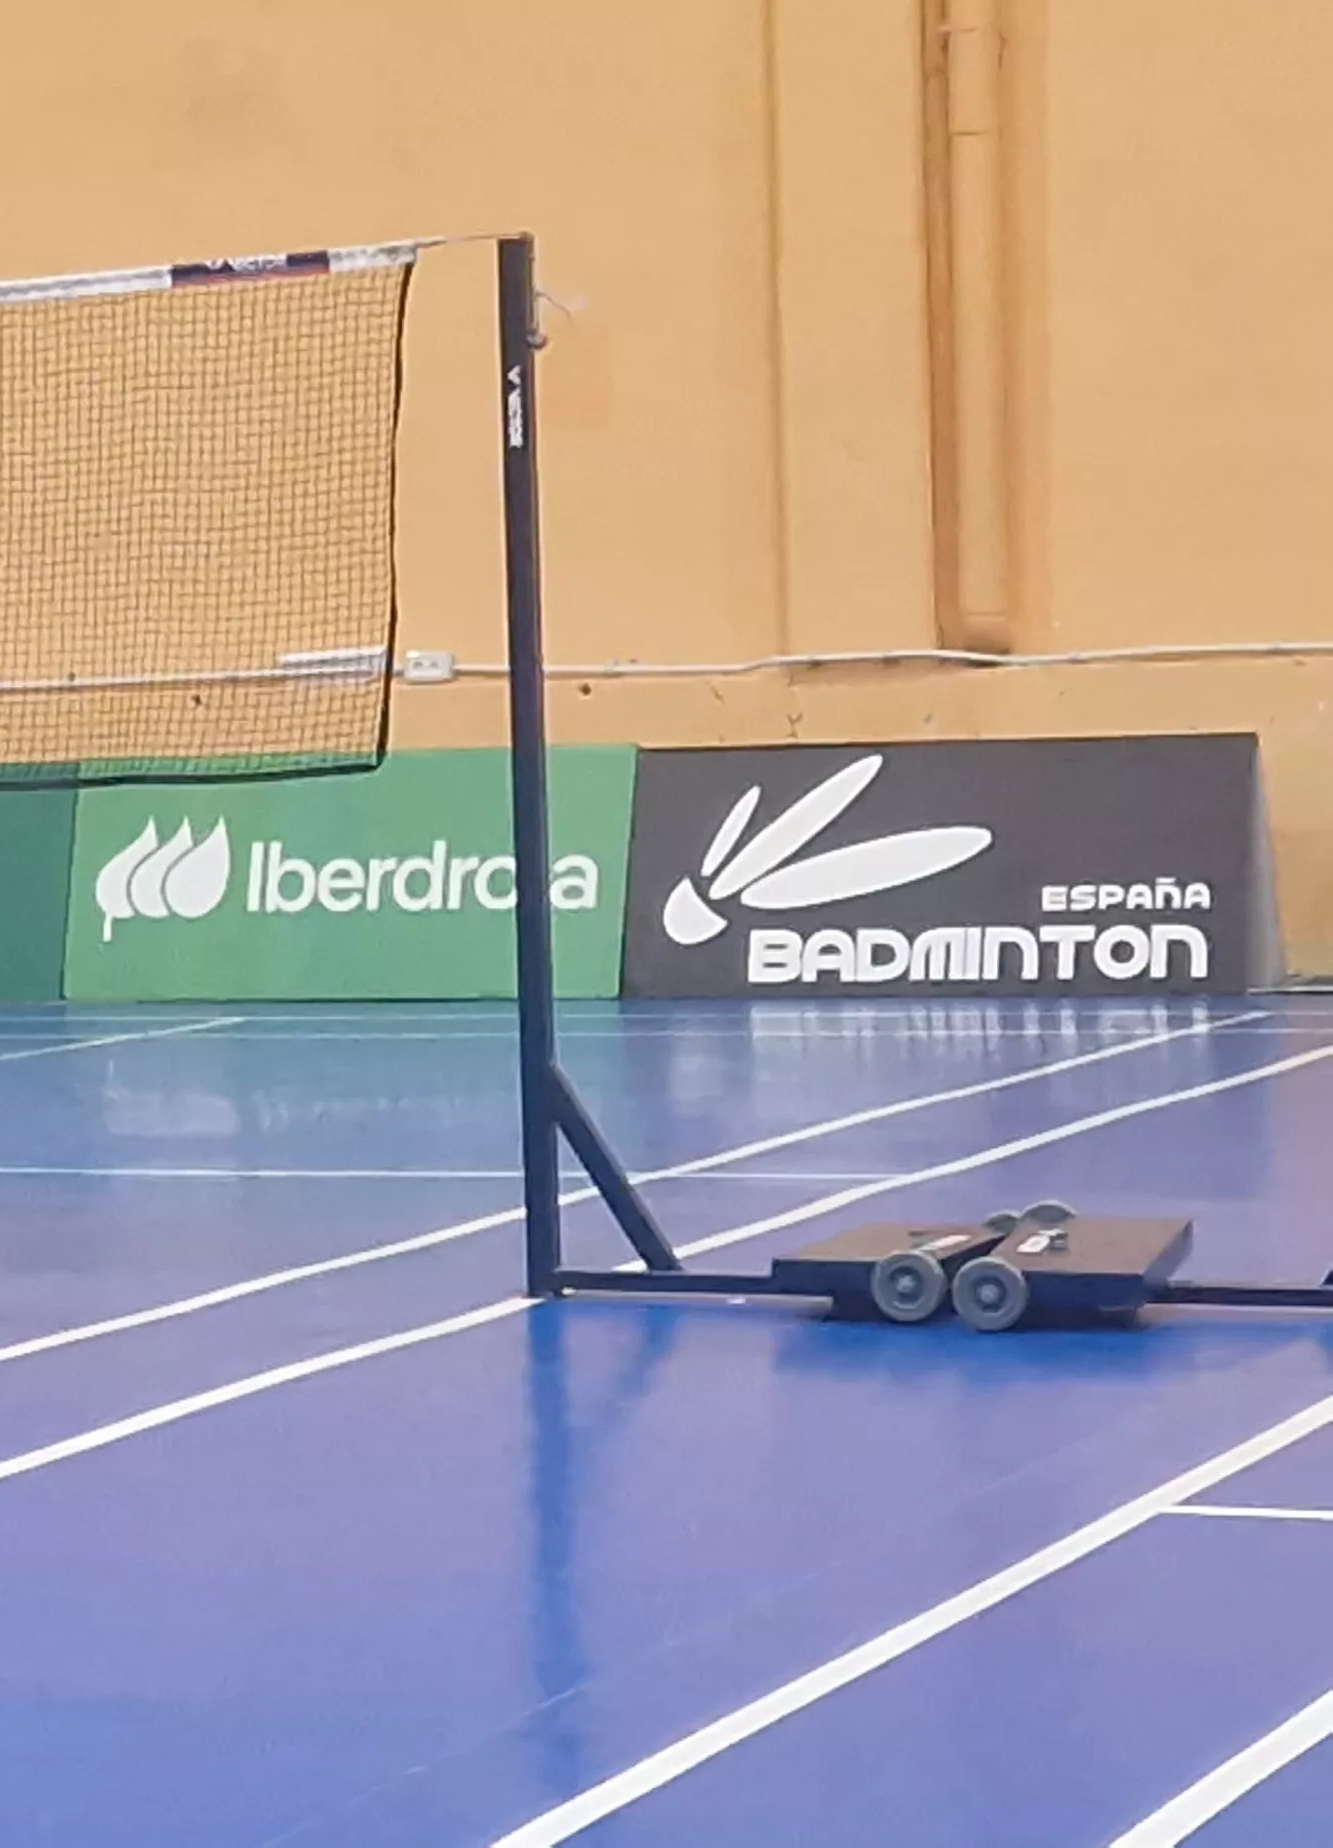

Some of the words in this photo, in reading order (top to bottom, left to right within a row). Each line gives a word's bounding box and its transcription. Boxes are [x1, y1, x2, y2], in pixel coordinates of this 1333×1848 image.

[247, 840, 598, 913] Iberdroa
[1041, 878, 1212, 912] ESPAÑA
[747, 924, 1209, 984] BADMINTON
